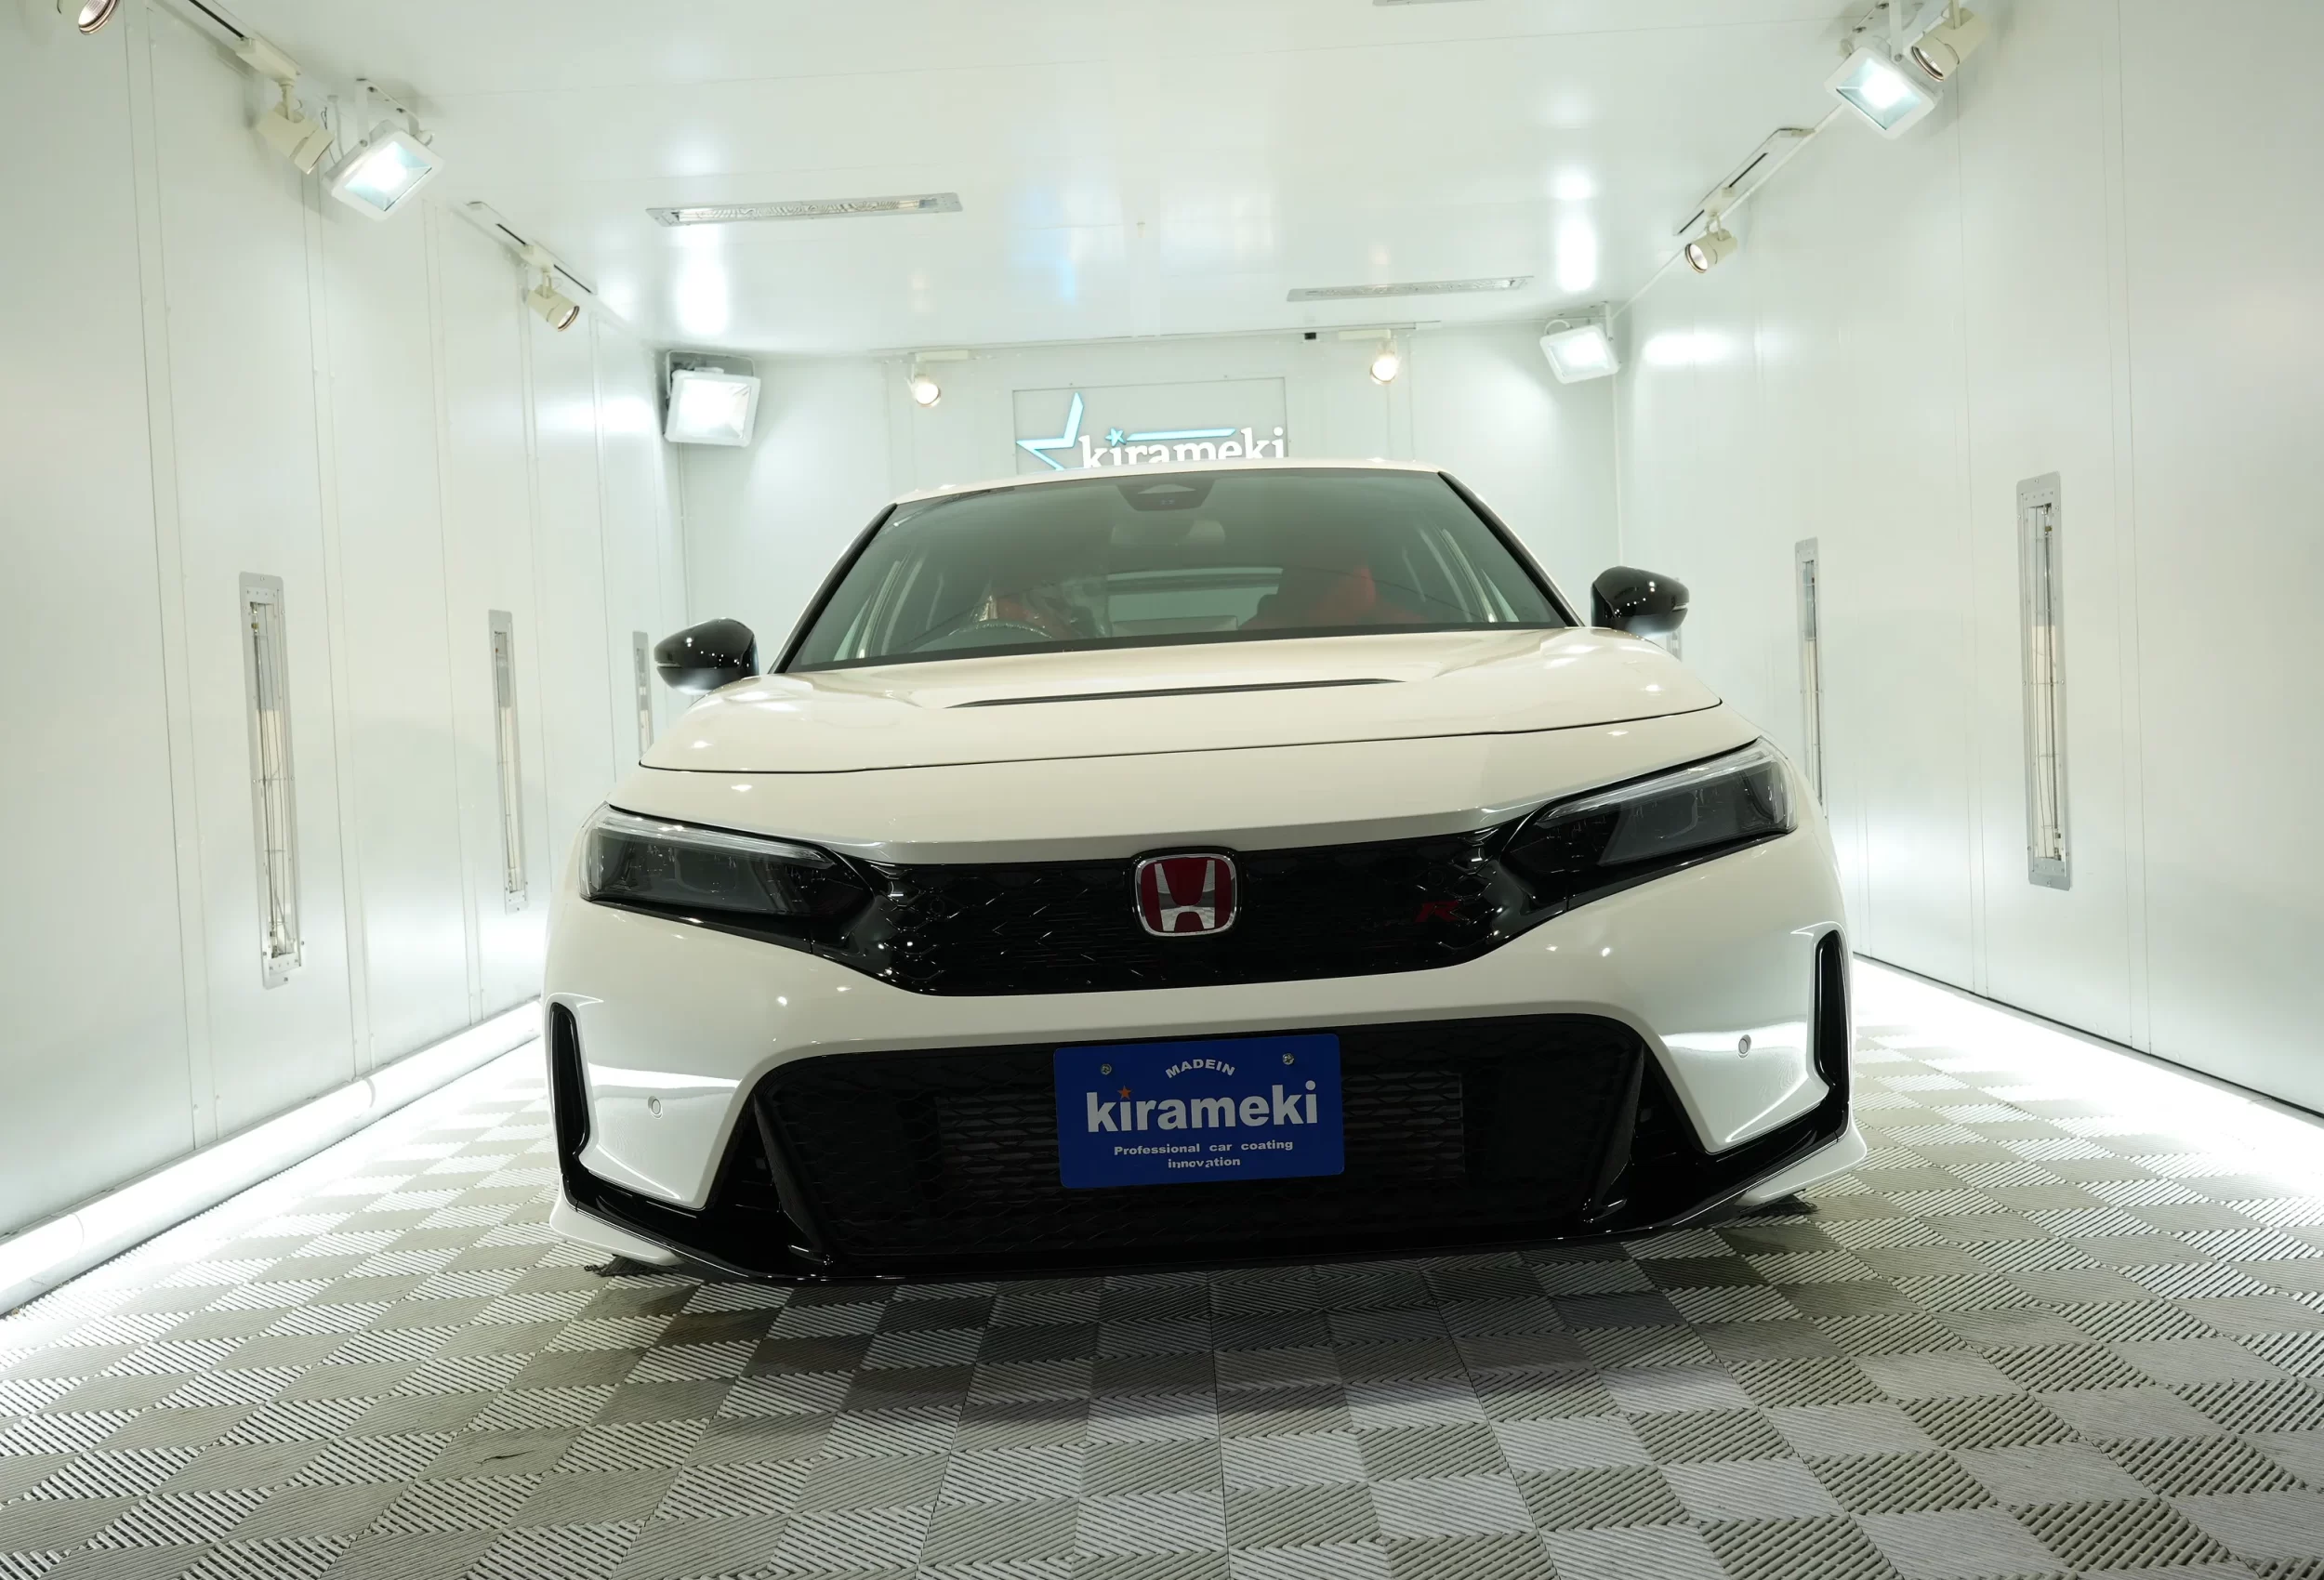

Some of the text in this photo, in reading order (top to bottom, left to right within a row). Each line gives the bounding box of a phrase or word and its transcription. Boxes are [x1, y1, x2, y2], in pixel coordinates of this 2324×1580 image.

[1078, 427, 1285, 468] kirameki
[1086, 1080, 1318, 1133] kirameki
[1114, 1139, 1294, 1155] Professional car coating
[1168, 1157, 1241, 1168] innovation
